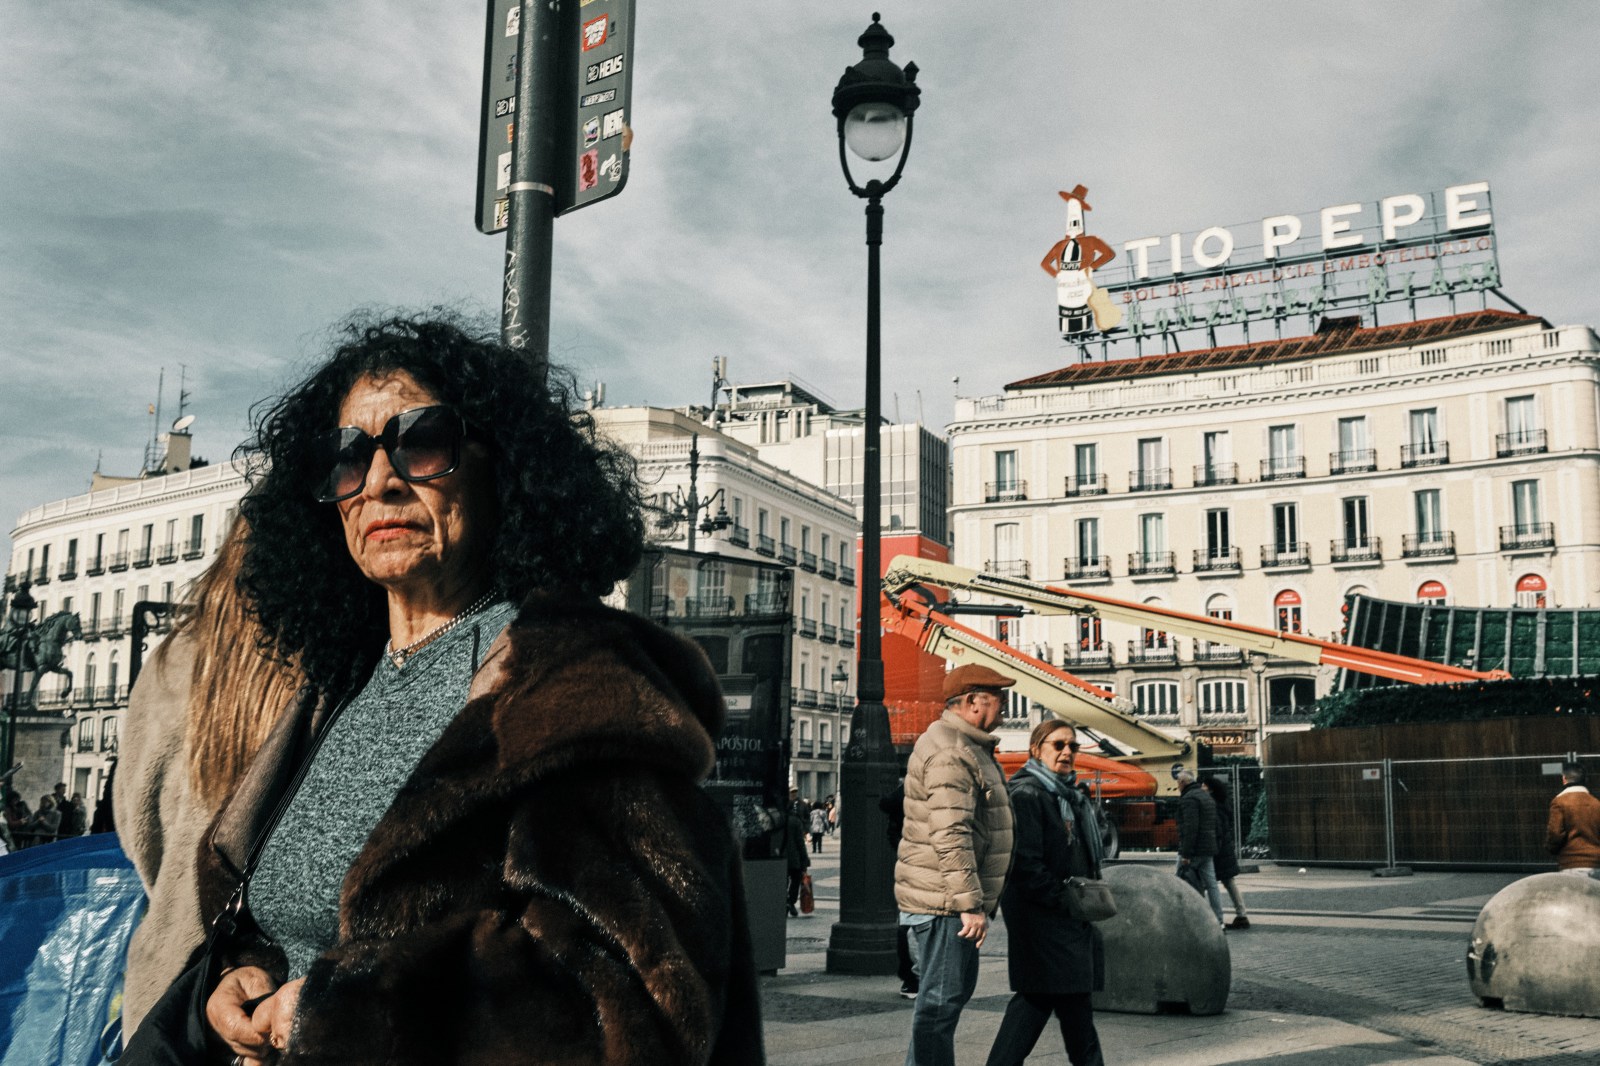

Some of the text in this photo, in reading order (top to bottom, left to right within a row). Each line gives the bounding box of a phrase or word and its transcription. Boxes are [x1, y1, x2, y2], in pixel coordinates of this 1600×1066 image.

[1124, 181, 1492, 279] TIO PEPE
[1122, 236, 1491, 304] SOL DE ANDALUCIA EMBOTELLADO
[1368, 260, 1498, 305] BYASS
